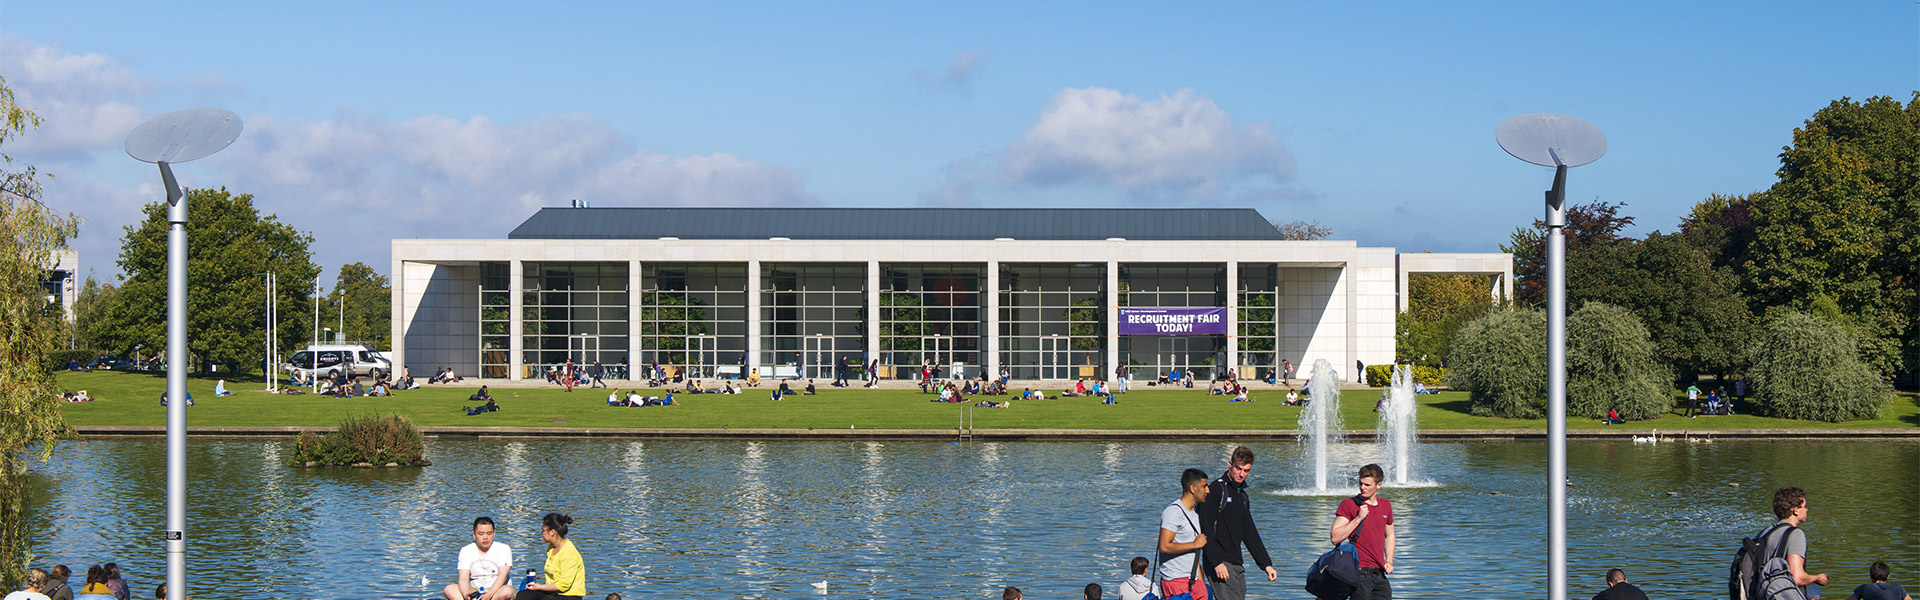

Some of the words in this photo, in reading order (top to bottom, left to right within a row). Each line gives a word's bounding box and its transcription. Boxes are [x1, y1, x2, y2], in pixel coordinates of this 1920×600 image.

[1128, 314, 1195, 324] RECRUITMENT
[1197, 314, 1220, 323] FAIR
[1155, 323, 1193, 333] TODAY!
